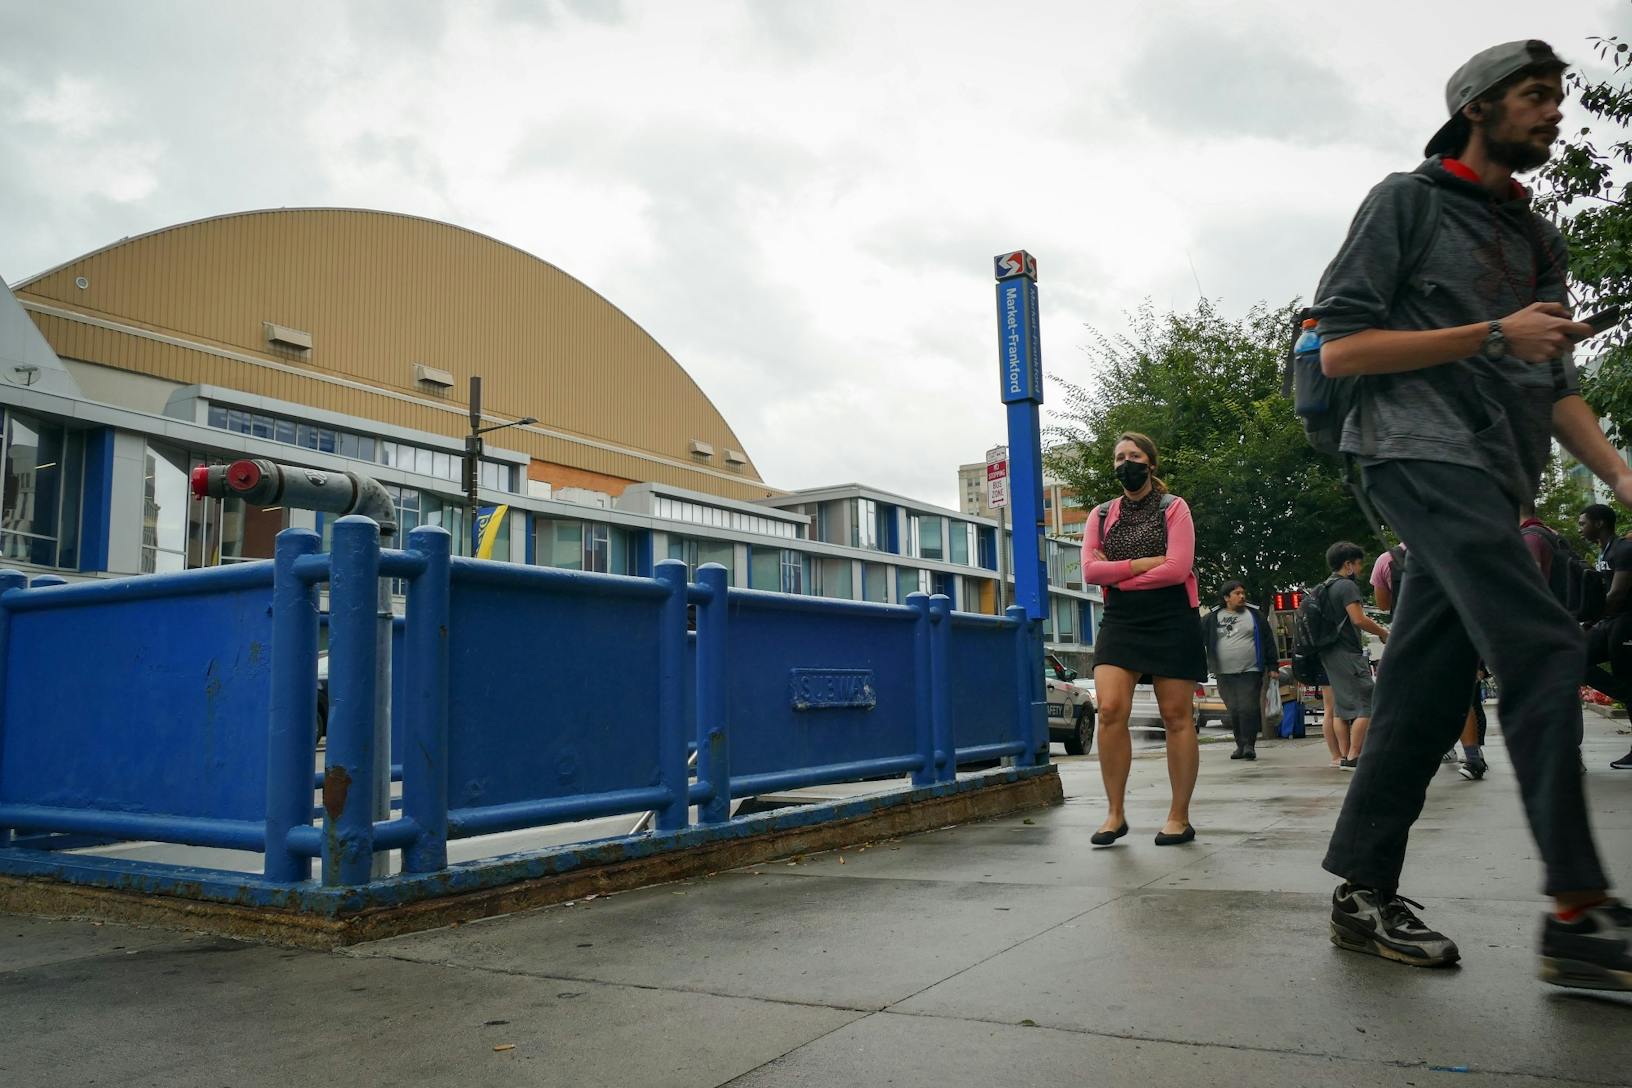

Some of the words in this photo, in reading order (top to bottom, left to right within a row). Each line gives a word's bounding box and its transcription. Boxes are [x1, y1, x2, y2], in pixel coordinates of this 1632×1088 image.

[1006, 287, 1021, 393] Market-Frankford
[992, 481, 1002, 490] BUS
[992, 489, 1004, 499] ZONE
[1221, 616, 1238, 625] NIKE
